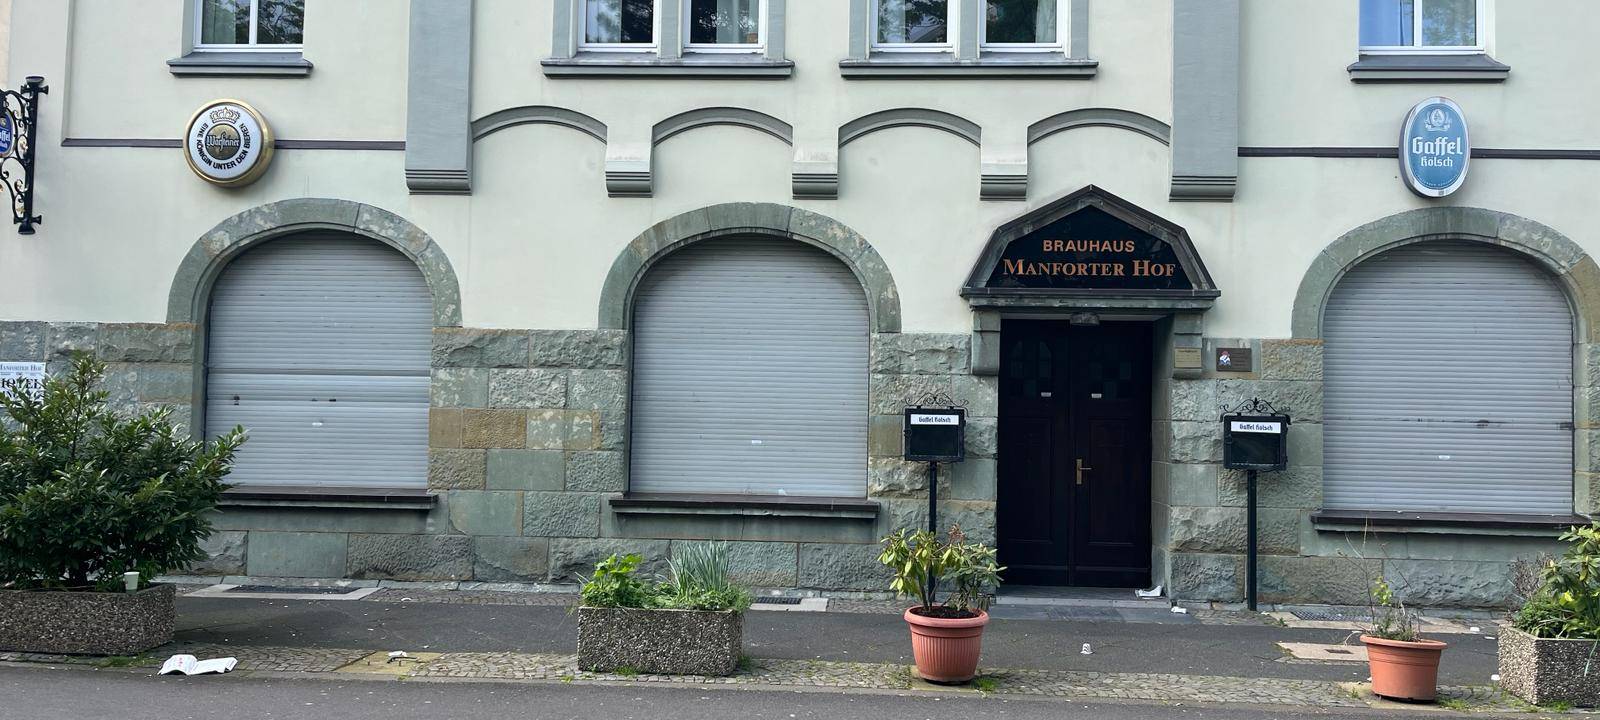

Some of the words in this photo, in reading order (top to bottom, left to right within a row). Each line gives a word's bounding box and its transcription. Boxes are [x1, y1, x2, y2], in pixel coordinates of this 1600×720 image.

[197, 123, 209, 138] EINE
[239, 123, 251, 149] BIEREN
[196, 139, 213, 166] KÖNIGIN
[1412, 136, 1464, 156] Gaffel
[235, 149, 249, 164] DEN
[1420, 155, 1453, 167] Kölsch
[212, 160, 237, 170] UNTER
[1043, 239, 1135, 253] BRAUHAUS
[1003, 258, 1126, 276] MANFORTER
[1132, 259, 1176, 277] HOF
